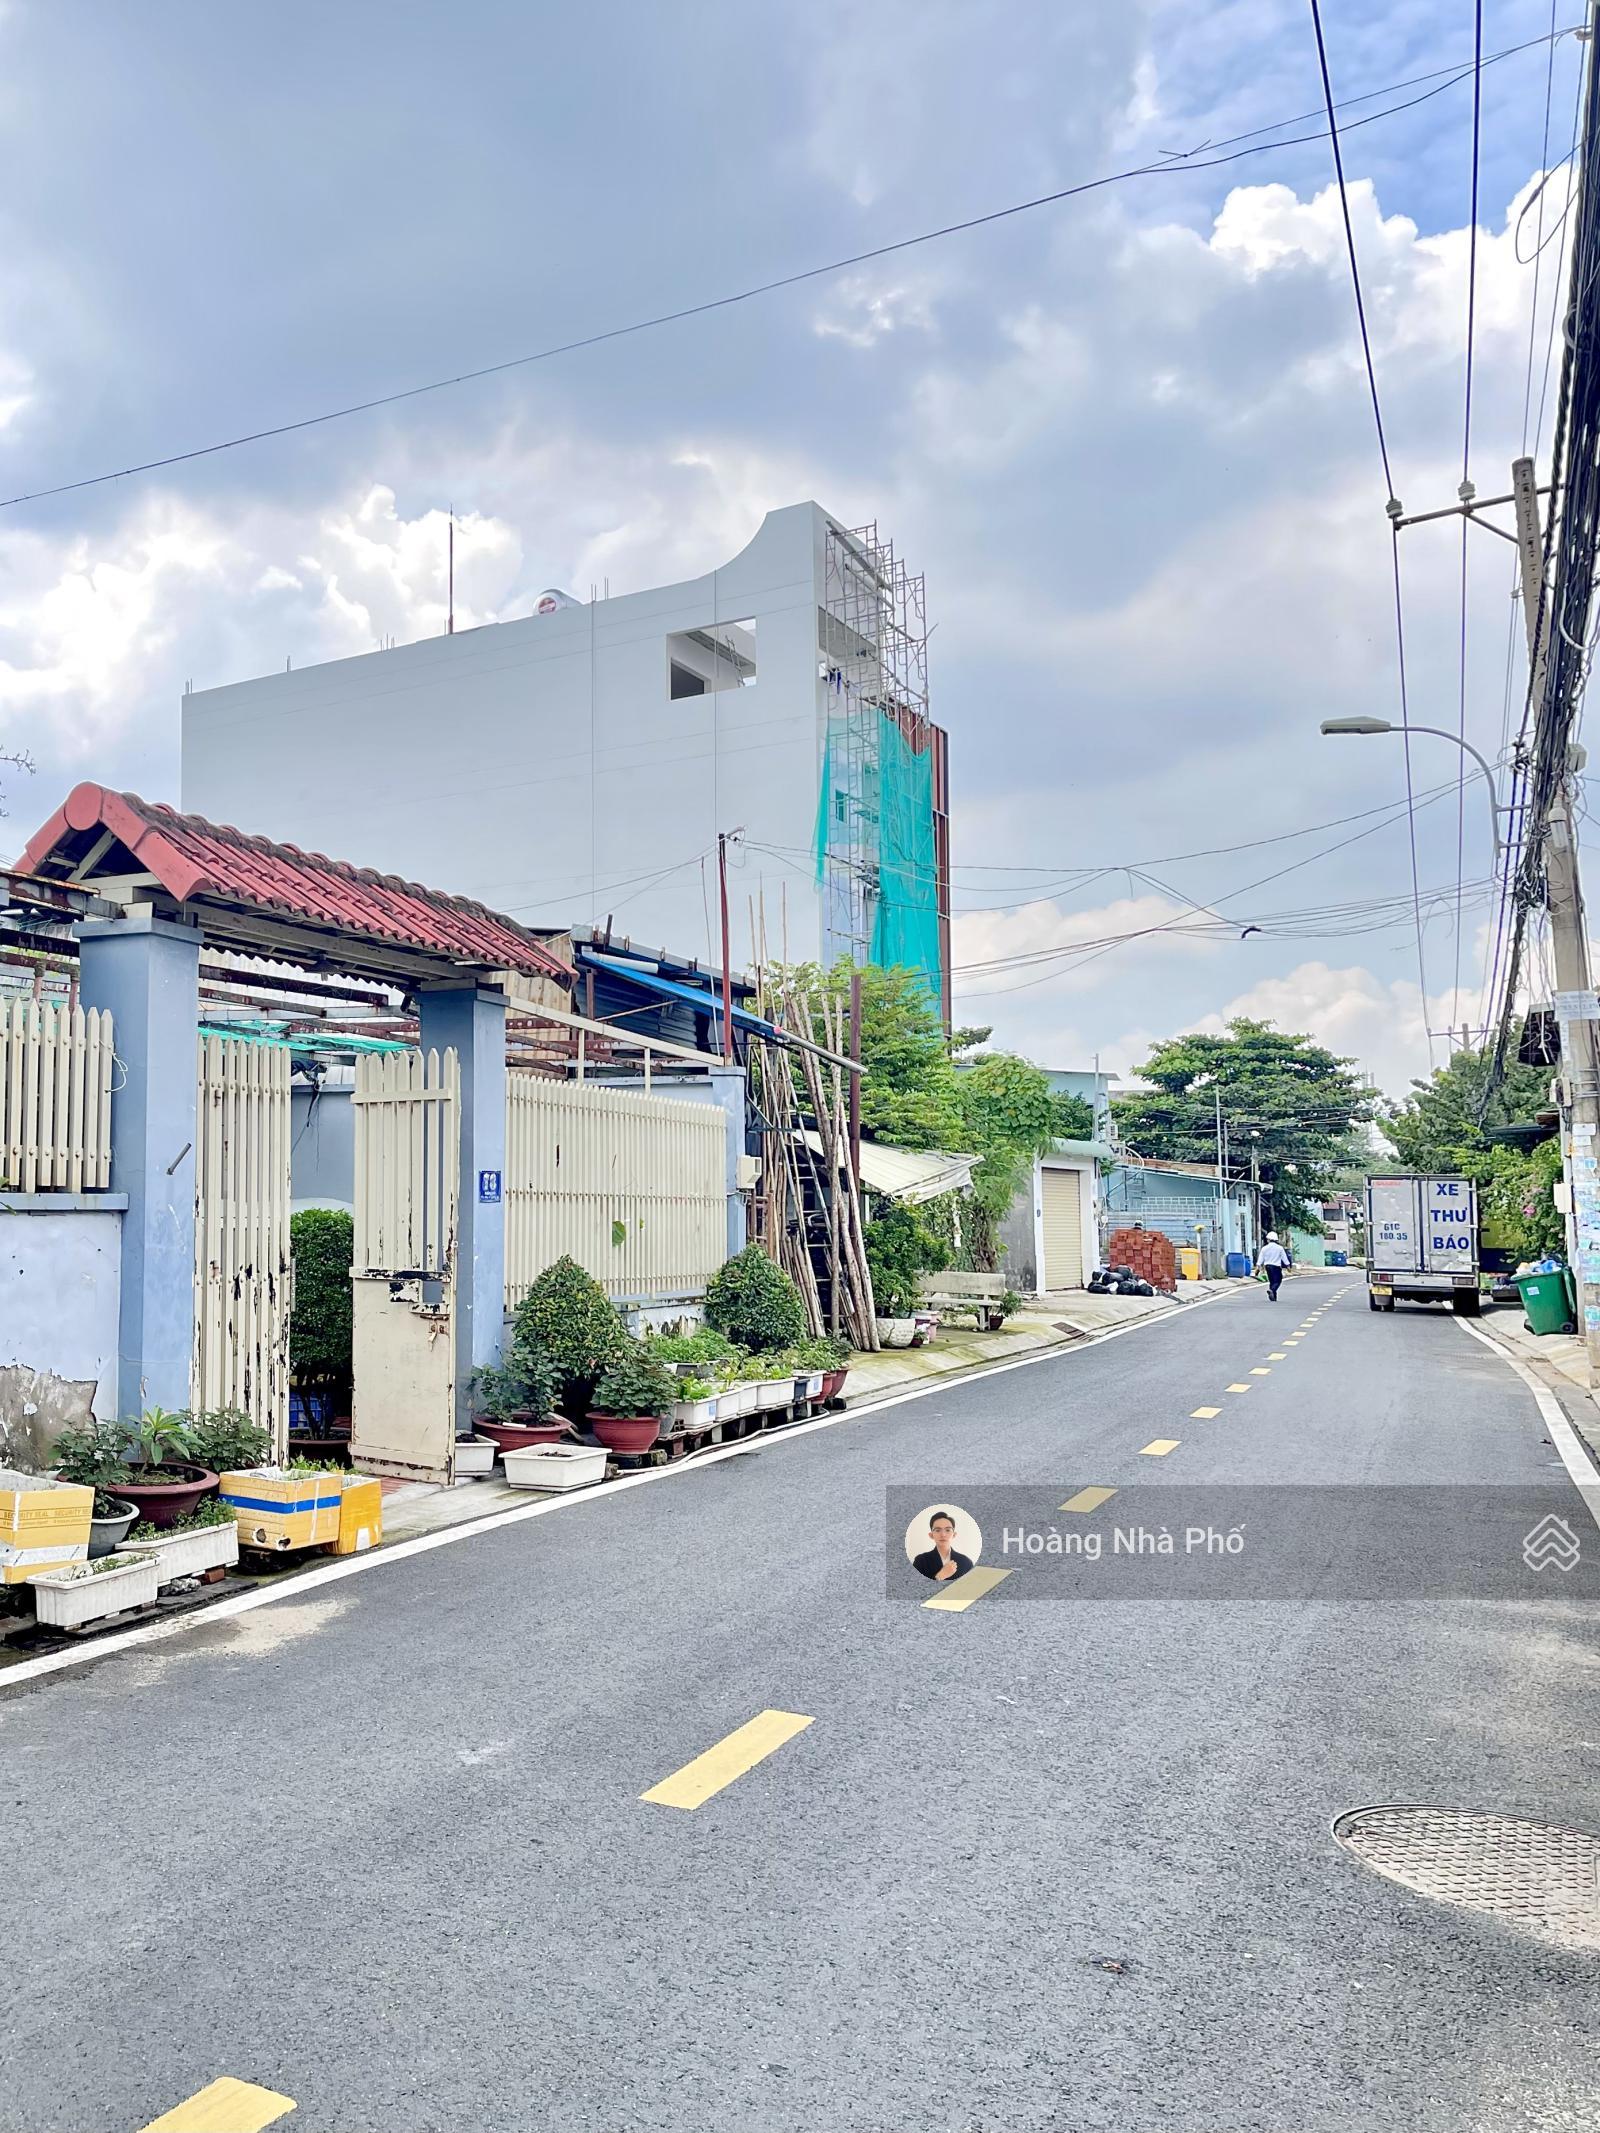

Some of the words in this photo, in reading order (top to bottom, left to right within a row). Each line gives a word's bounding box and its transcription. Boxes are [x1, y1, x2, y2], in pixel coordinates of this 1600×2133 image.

[1436, 1183, 1459, 1196] XE
[1430, 1207, 1468, 1223] THƯ
[1433, 1234, 1469, 1250] BÁO
